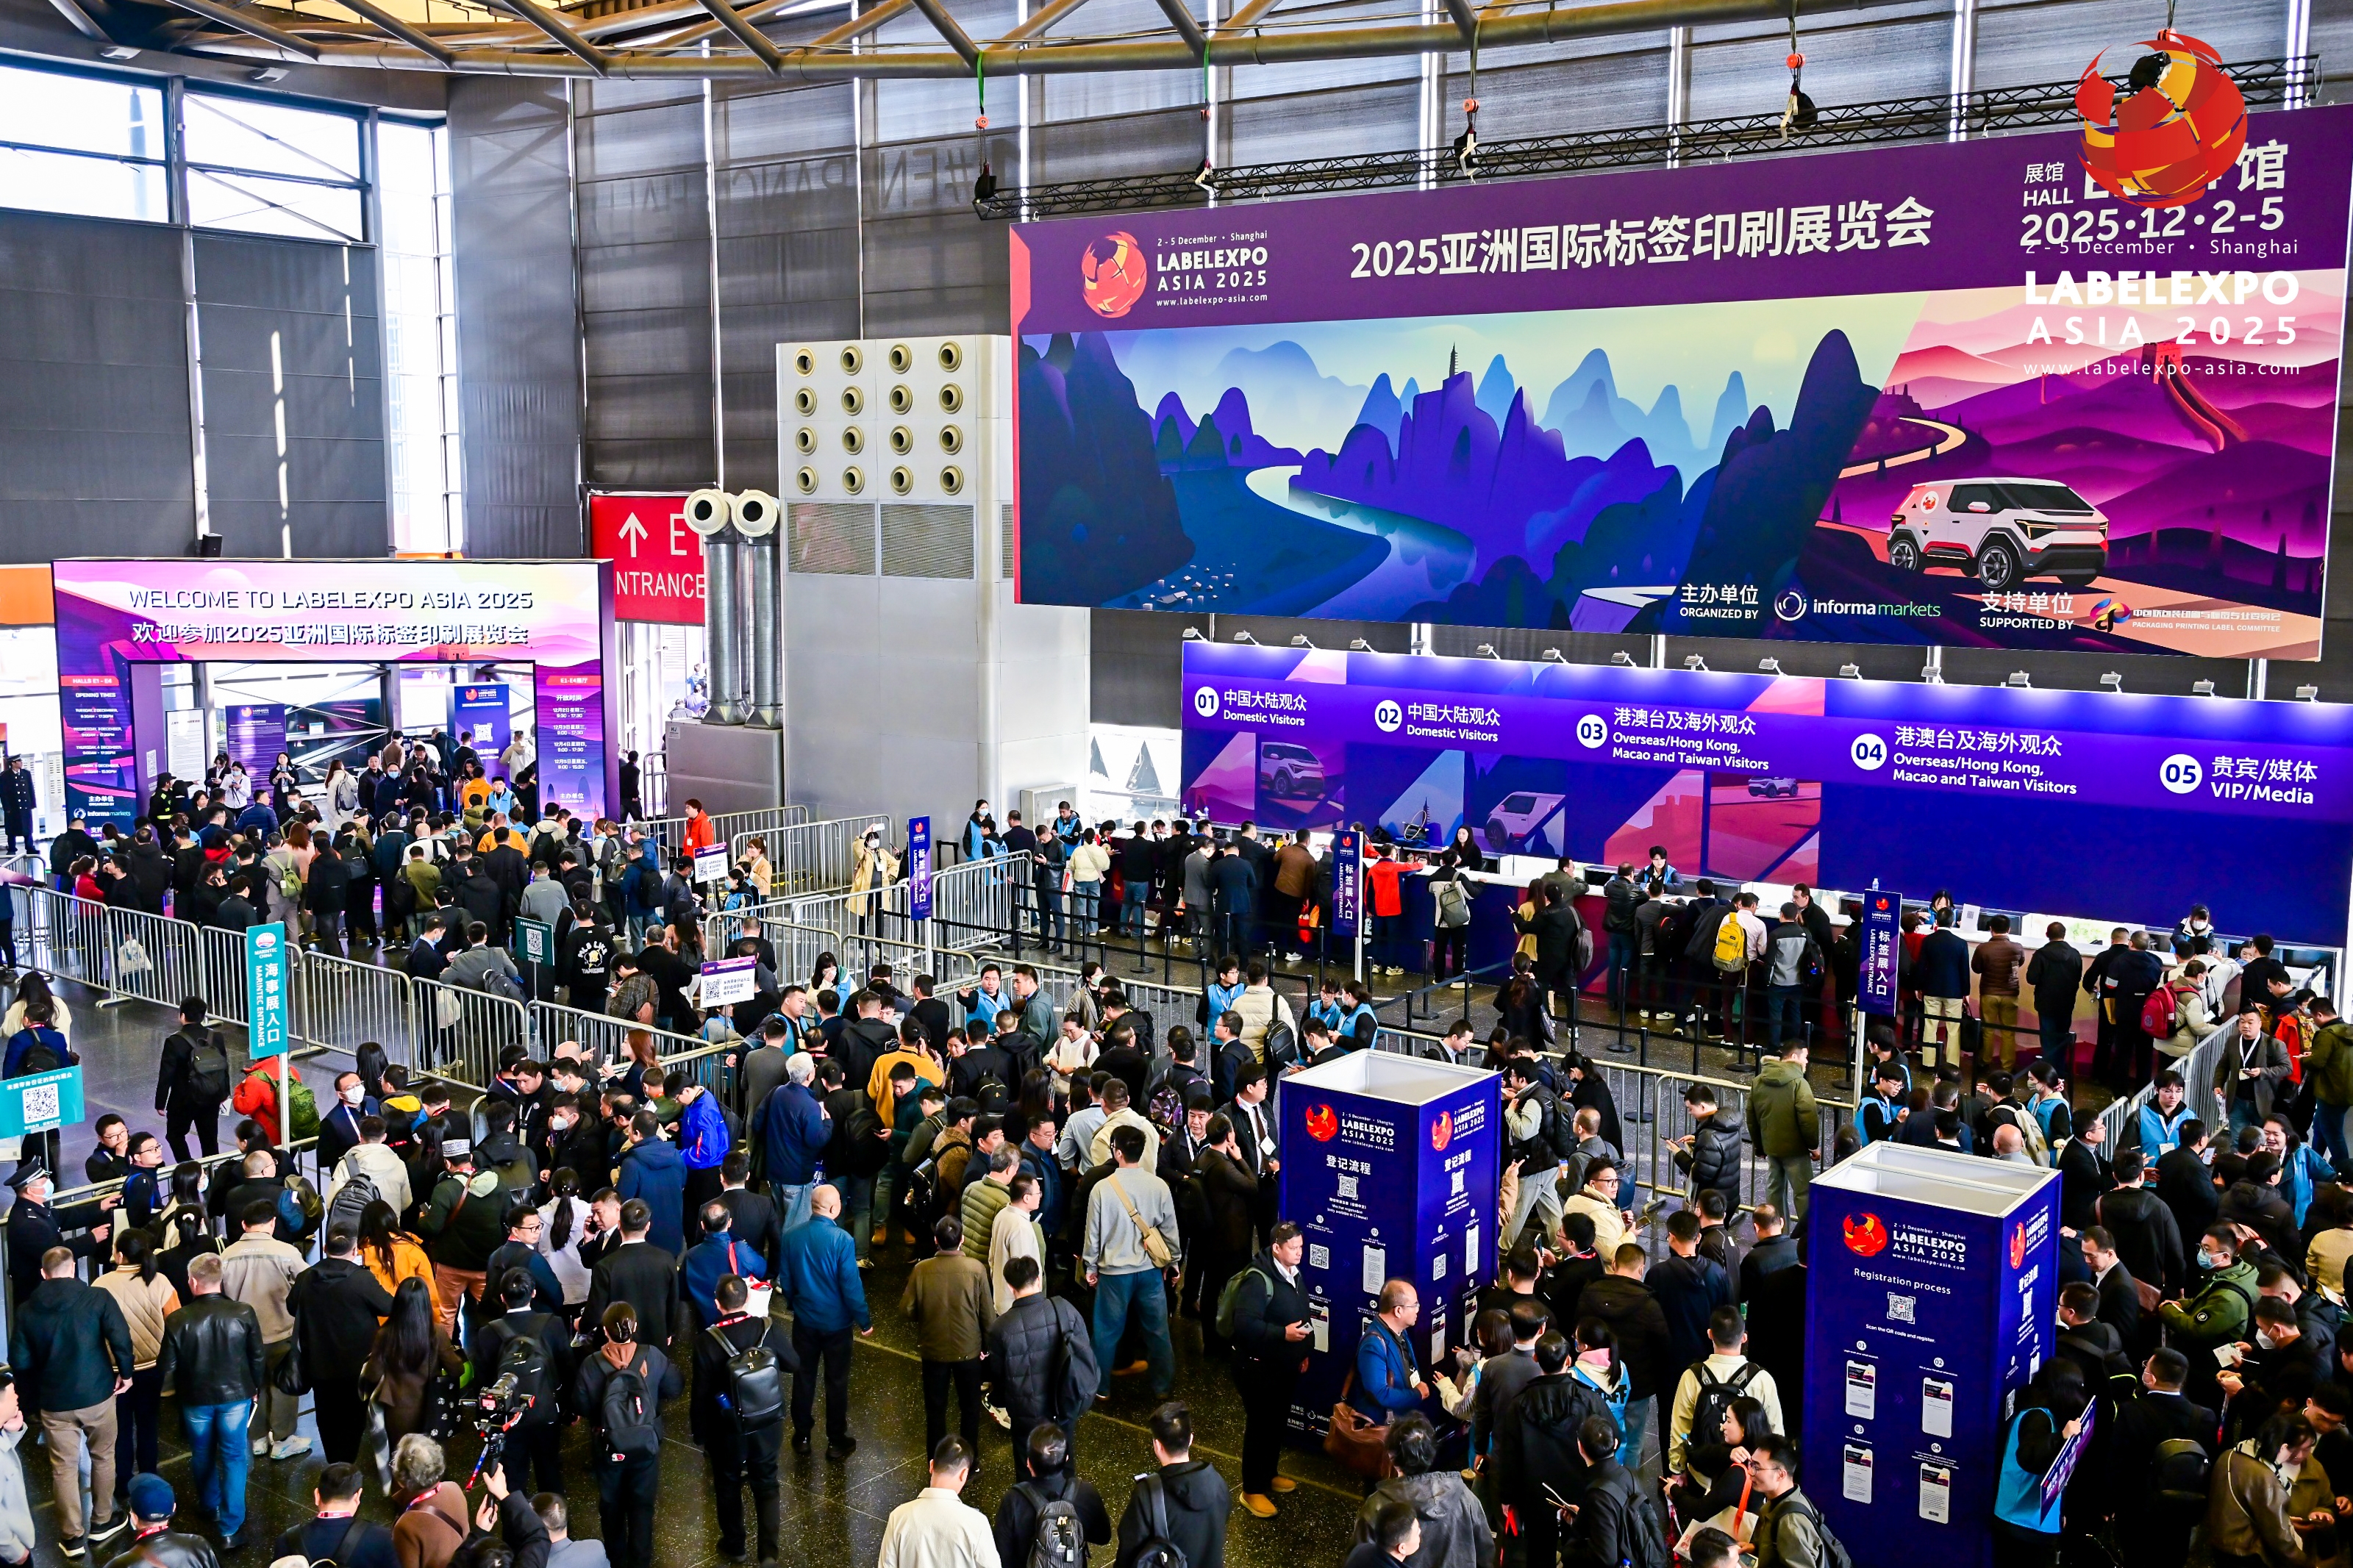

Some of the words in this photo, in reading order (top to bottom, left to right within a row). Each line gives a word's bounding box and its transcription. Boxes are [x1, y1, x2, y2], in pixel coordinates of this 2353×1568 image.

[2024, 162, 2065, 184] 展馆
[2023, 187, 2074, 207] HALL
[1157, 238, 1163, 246] 2
[1171, 237, 1175, 246] 5
[1178, 235, 1217, 246] December
[1230, 230, 1268, 243] Shanghai
[1350, 195, 1935, 279] 2025亚洲国际标签印刷展览会
[1157, 246, 1268, 271] LABELEXPO
[1157, 273, 1205, 292] ASIA
[1216, 270, 1267, 288] 2025
[1156, 294, 1268, 307] www.labelexpo-asia.com
[616, 571, 705, 598] NTRANCE
[1680, 583, 1759, 605] 主办单位
[130, 590, 239, 609] WELCOME
[246, 591, 274, 609] TO
[282, 591, 413, 609] LABELEXPO
[421, 591, 471, 609] ASIA
[477, 591, 533, 609] 2025
[1979, 591, 2074, 615] 支持单位
[1679, 607, 1743, 619] ORGANIZED
[1744, 609, 1759, 619] BY
[1979, 617, 2054, 630] SUPPORTED
[2057, 618, 2074, 630] BY
[132, 621, 529, 645] 欢迎参加2025亚洲国际标签印刷展览会
[2132, 621, 2174, 629] PACKAGING
[1198, 693, 1215, 710] 01
[1224, 688, 1307, 712] 中国大陆观众
[1224, 709, 1267, 725] Domestic
[1269, 712, 1305, 727] Visitors
[1378, 707, 1399, 725] 02
[1407, 702, 1501, 727] 中国大陆观众
[1613, 707, 1757, 736] 港澳台及海外观众
[1407, 724, 1456, 740] Domestic
[1457, 728, 1499, 743] Visitors
[1580, 723, 1603, 741] 03
[1613, 731, 1703, 751] Overseas/Hong
[1705, 738, 1741, 754] Kong,
[1894, 726, 2063, 756] 港澳台及海外观众
[1613, 746, 1651, 762] Macao
[1653, 749, 1675, 763] and
[1677, 752, 1721, 767] Taiwan
[1723, 755, 1769, 770] Visitors
[1855, 742, 1883, 762] 04
[1893, 751, 1999, 775] Overseas/Hong
[2003, 760, 2044, 777] Kong,
[2165, 763, 2196, 784] 05
[2211, 755, 2318, 783] 贵宾/媒体
[1893, 768, 1938, 784] Macao
[1940, 773, 1966, 787] and
[1968, 774, 2020, 790] Taiwan
[2023, 778, 2077, 795] Visitors
[2210, 781, 2314, 804] VIP/Media
[918, 848, 926, 903] 标签展入口
[1345, 864, 1354, 920] 标签展入口
[254, 948, 278, 956] MARINTEC
[1877, 930, 1890, 995] 标签展入口
[256, 965, 264, 1005] MARINTEC
[265, 963, 280, 1043] 海事展入口
[257, 1007, 265, 1048] ENTRANCE
[1454, 1106, 1485, 1125] LABELEXPO
[1454, 1122, 1468, 1134] ASIA
[1470, 1114, 1485, 1127] 2025
[1342, 1118, 1395, 1136] LABELEXPO
[1342, 1128, 1365, 1140] ASIA
[1369, 1134, 1394, 1145] 2025
[1326, 1154, 1371, 1175] 登记流程
[1444, 1149, 1471, 1173] 登记流程
[1893, 1230, 1966, 1253] LABELEXPO
[1907, 1225, 1933, 1234] December
[1941, 1231, 1966, 1240] Shanghai
[2026, 1234, 2037, 1248] ASIA
[2037, 1223, 2048, 1239] 2025
[1892, 1253, 1965, 1271] www.labelexpo-asia.com
[1893, 1242, 1925, 1256] ASIA
[1932, 1249, 1965, 1263] 2025
[1854, 1267, 1912, 1287] Registration
[1913, 1281, 1951, 1295] process
[1916, 1335, 1936, 1343] register.
